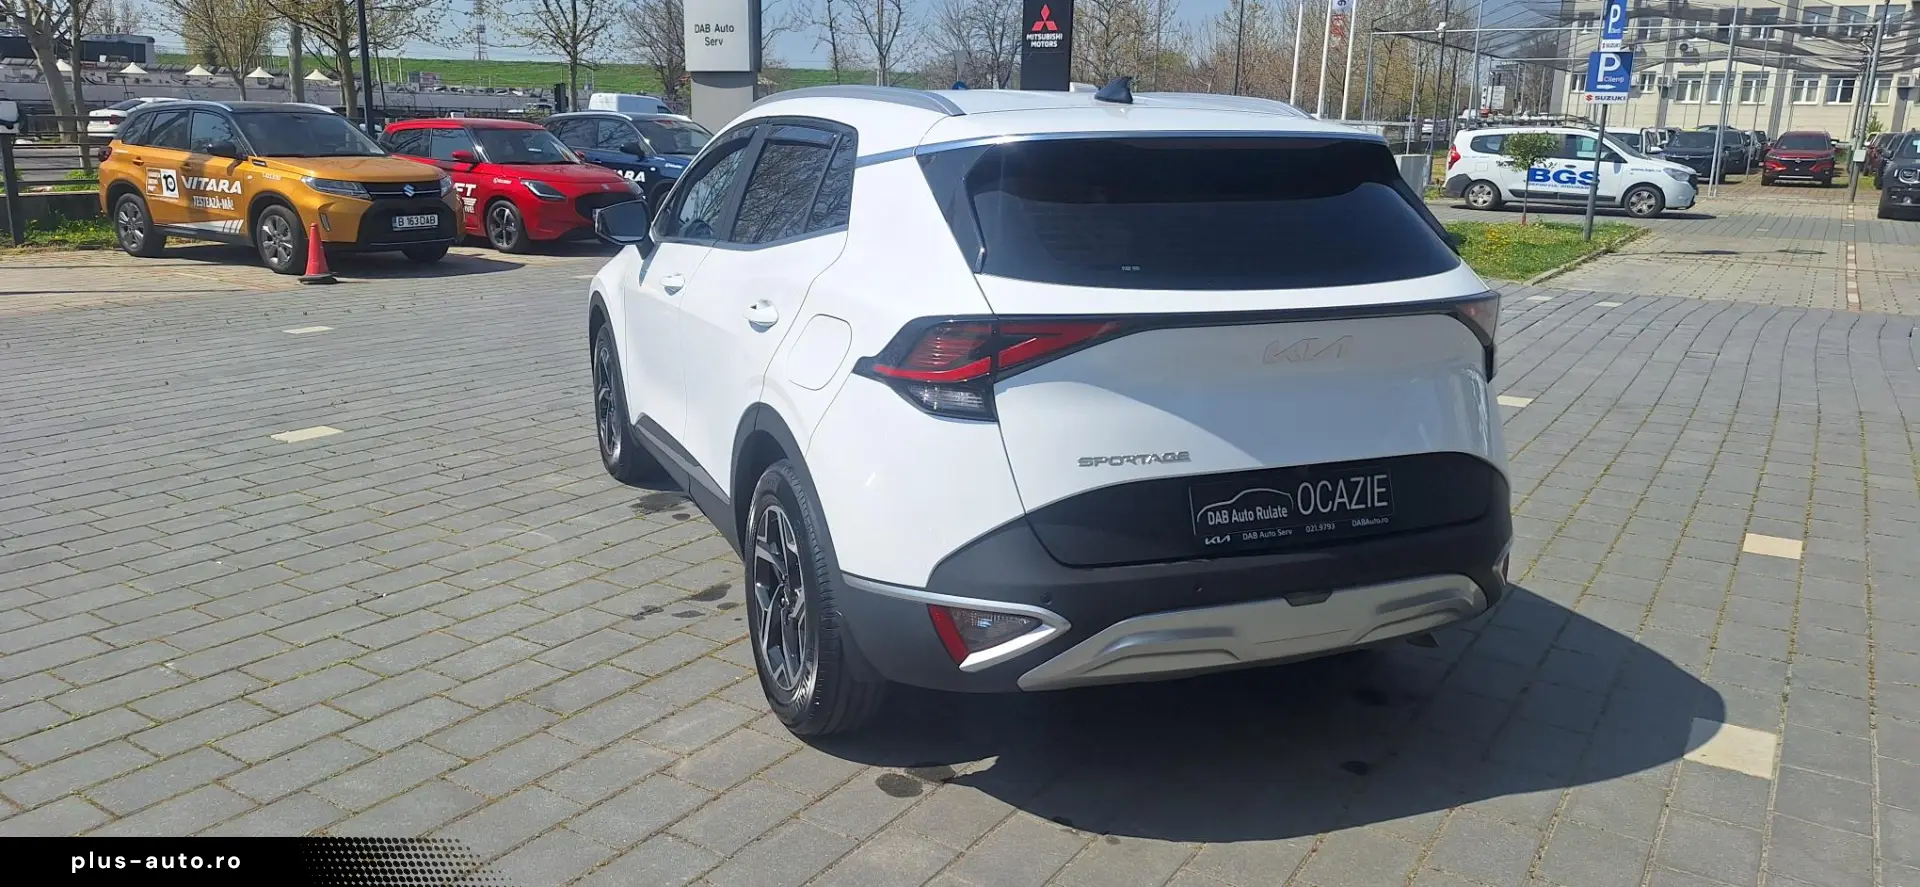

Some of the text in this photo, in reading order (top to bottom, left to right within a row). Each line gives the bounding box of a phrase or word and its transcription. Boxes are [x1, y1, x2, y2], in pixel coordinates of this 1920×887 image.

[1608, 4, 1621, 34] P
[694, 23, 735, 34] DAB Auto
[1026, 33, 1063, 41] MITSUBISHI
[704, 36, 723, 47] Serv
[1030, 40, 1058, 48] MOTORS
[1597, 53, 1621, 82] P
[181, 175, 242, 195] VITARA
[1528, 168, 1600, 185] BGS
[398, 215, 436, 226] B 163 DAB
[1078, 450, 1192, 468] SPORTAGE
[1297, 474, 1388, 515] OCAZIE
[1208, 505, 1288, 526] DAB Auto Rulate
[1242, 530, 1258, 541] DAB
[1260, 529, 1277, 540] Auto
[1278, 528, 1293, 538] Serv
[1305, 523, 1336, 533] 021.9793
[1351, 516, 1389, 528] DABAuto.ro
